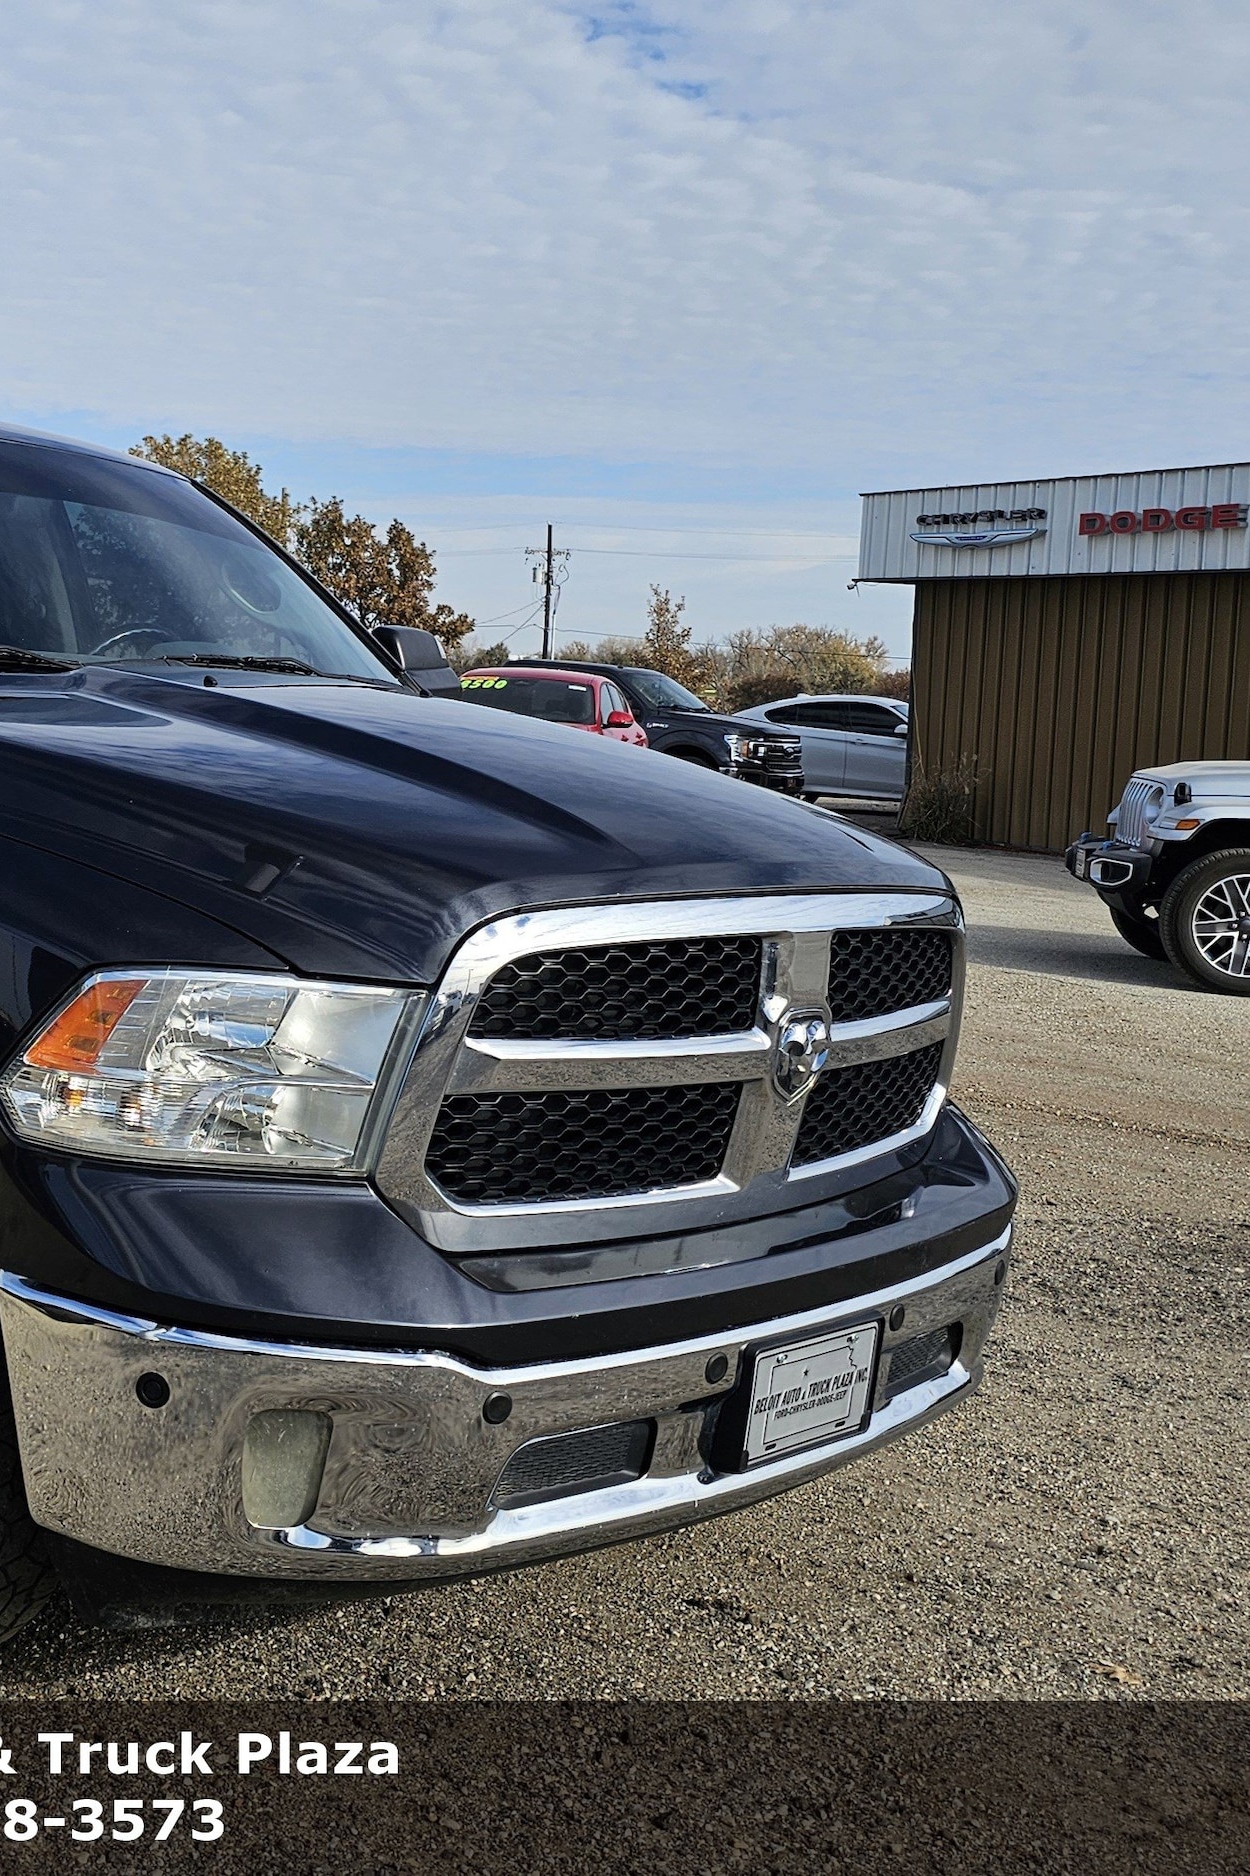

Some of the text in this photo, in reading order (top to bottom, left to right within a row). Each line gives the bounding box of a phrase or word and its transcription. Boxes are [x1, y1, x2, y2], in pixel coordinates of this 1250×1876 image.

[916, 507, 1047, 526] CHRYSLER
[1079, 503, 1249, 536] DODGE
[754, 1393, 782, 1415] BELOIT
[781, 1387, 803, 1407] AUTO
[808, 1377, 833, 1399] TRUCK
[831, 1371, 855, 1391] PLAZA
